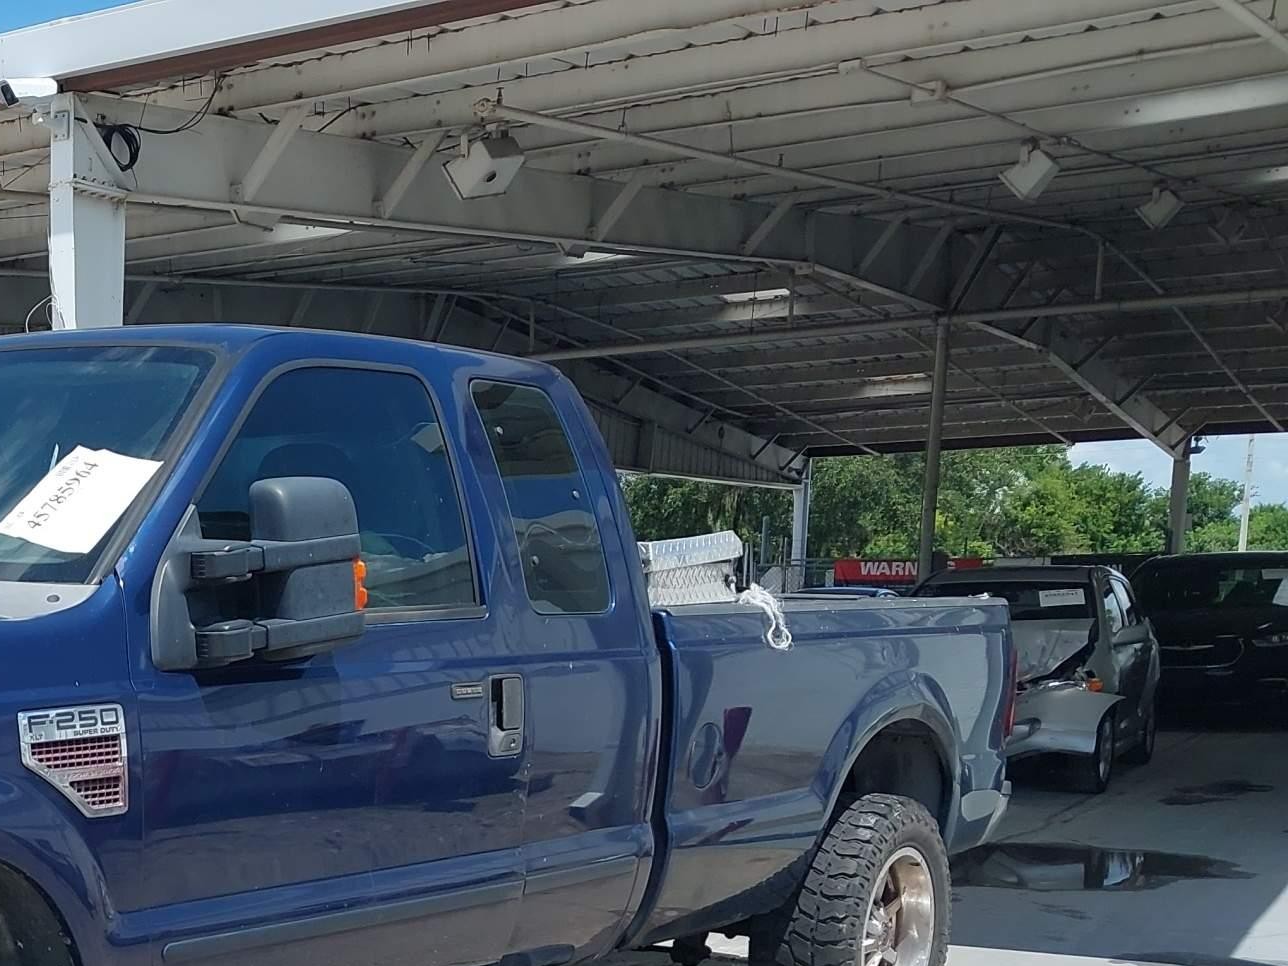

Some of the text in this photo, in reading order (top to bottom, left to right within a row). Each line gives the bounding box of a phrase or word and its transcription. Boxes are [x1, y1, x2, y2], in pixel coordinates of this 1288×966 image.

[27, 462, 99, 529] 45785964
[27, 707, 119, 733] F-250
[29, 733, 43, 741] XLT
[73, 726, 121, 737] SUPER DUTY
